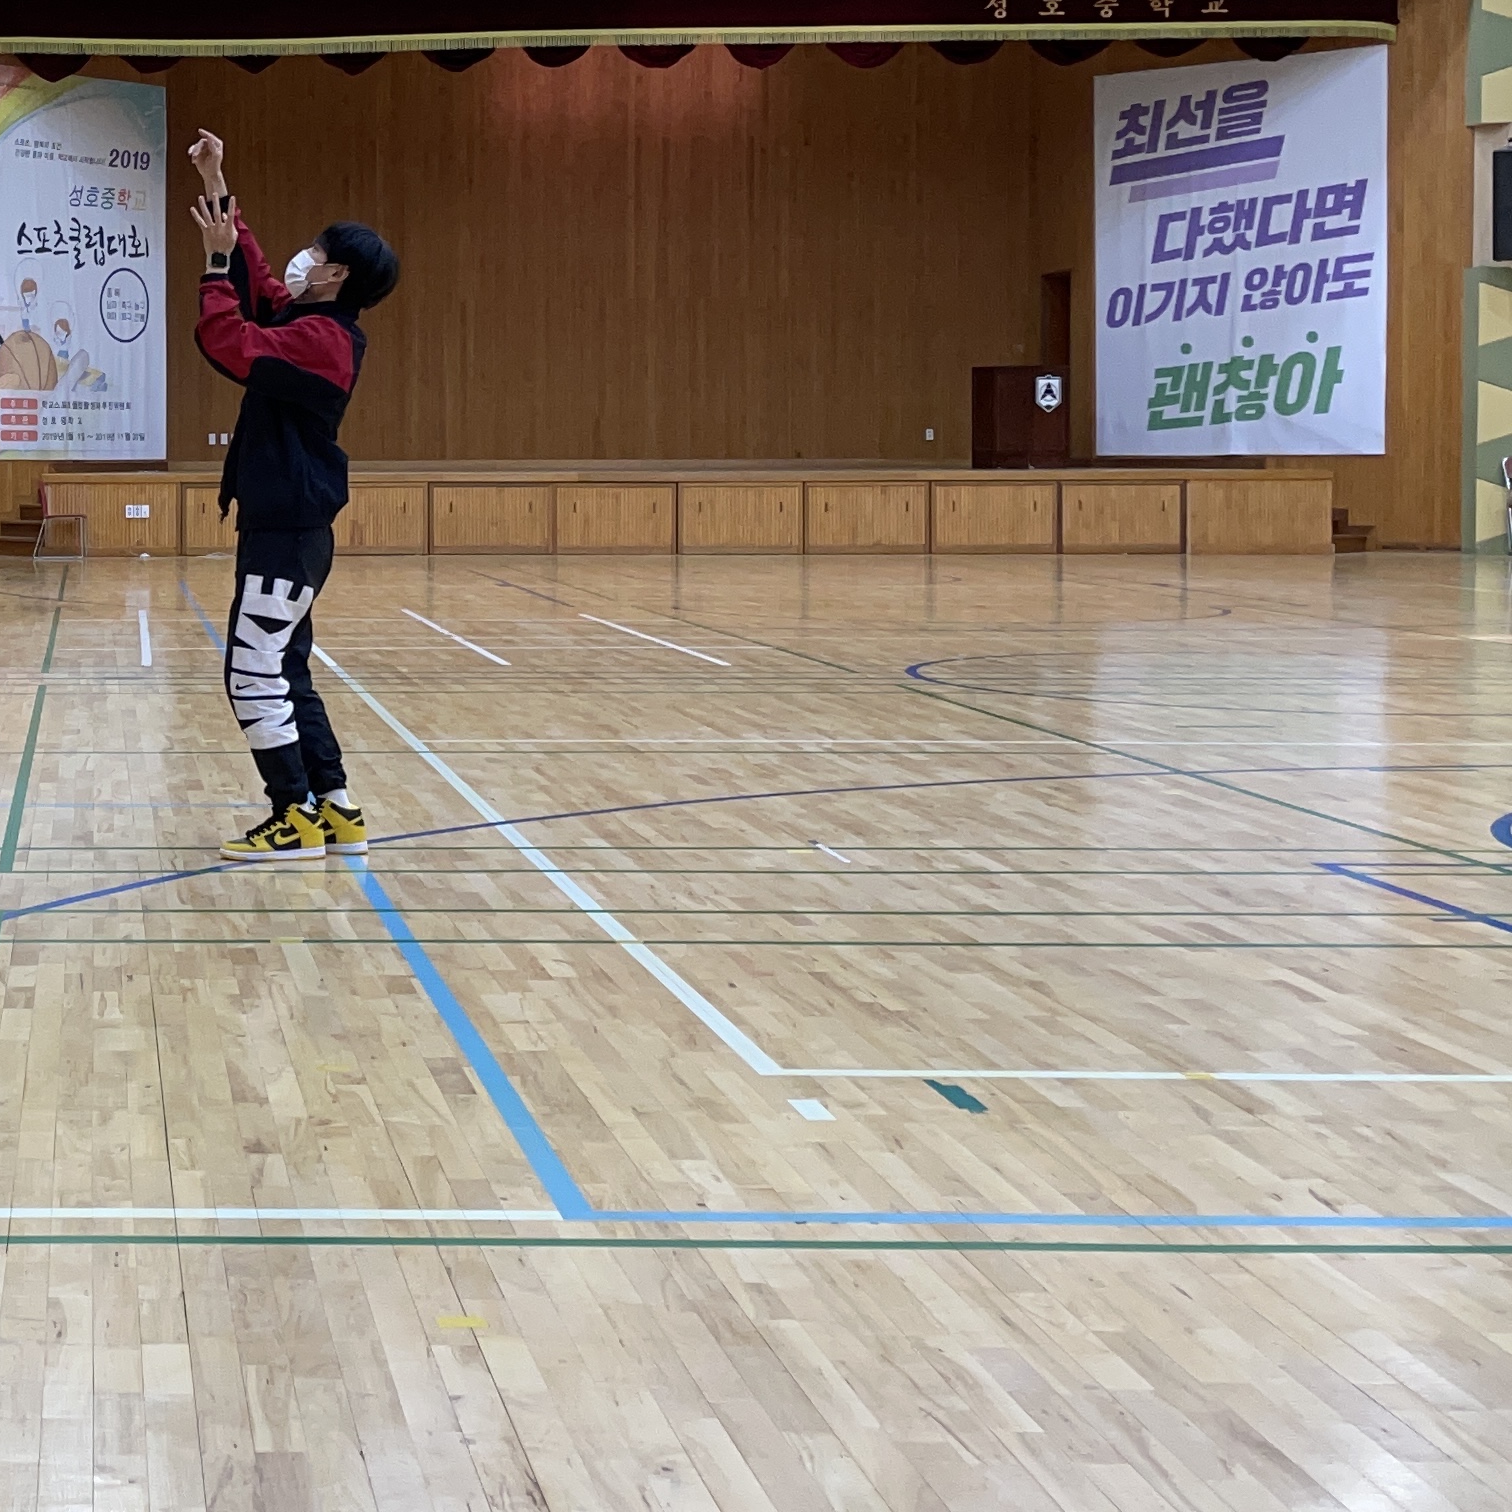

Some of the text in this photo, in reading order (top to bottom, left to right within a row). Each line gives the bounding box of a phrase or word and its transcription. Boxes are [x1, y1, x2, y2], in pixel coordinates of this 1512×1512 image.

[108, 148, 151, 171] 2019
[1110, 79, 1270, 161] 최선을
[68, 184, 147, 212] 성호중학교
[1150, 178, 1369, 265] 다했다면
[16, 217, 150, 271] 스포츠클럽대회
[1105, 252, 1375, 329] 이기지 않아도
[1146, 345, 1345, 431] 괜찮아
[230, 573, 315, 750] NIKE
